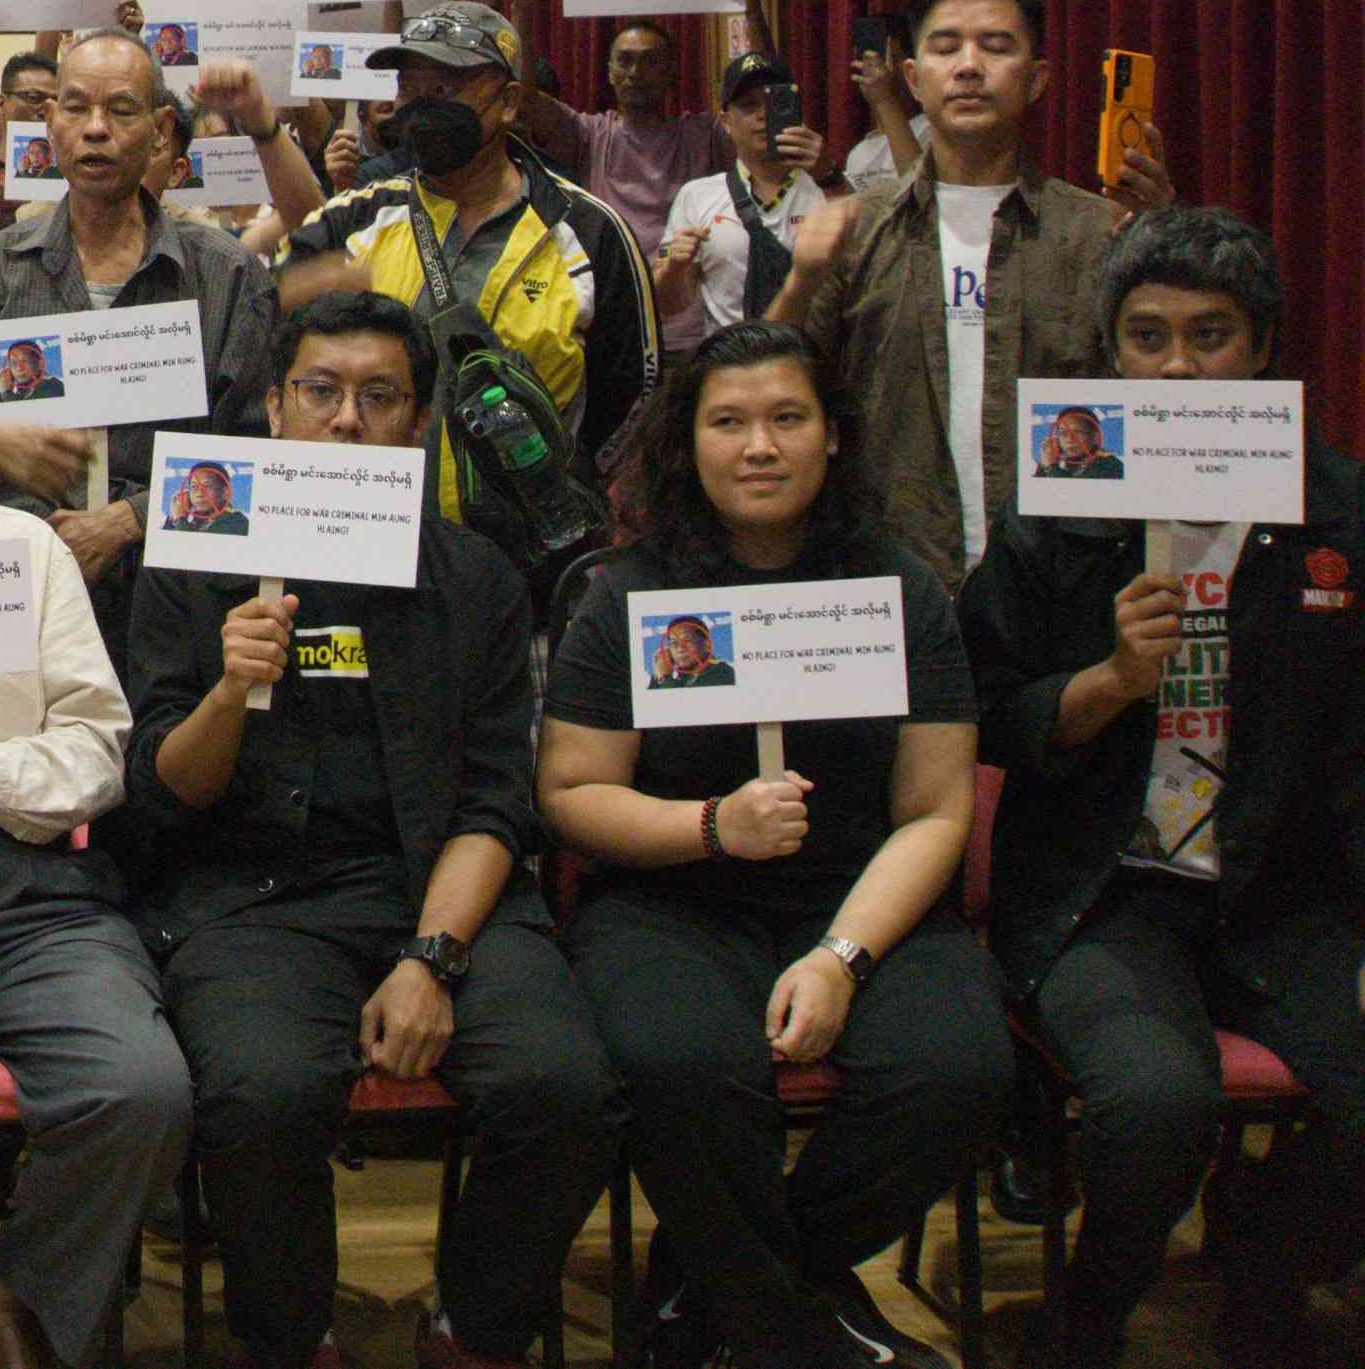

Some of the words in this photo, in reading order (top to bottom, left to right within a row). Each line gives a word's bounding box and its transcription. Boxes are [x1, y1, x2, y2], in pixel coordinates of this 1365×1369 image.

[259, 506, 269, 515] NO
[272, 506, 294, 516] PLACE
[296, 508, 310, 517] FOR
[313, 509, 329, 518] WAR
[332, 510, 369, 521] CRIMINAL
[371, 513, 387, 522] MIN
[389, 514, 411, 524] AUNG
[3, 602, 25, 613] AUNG
